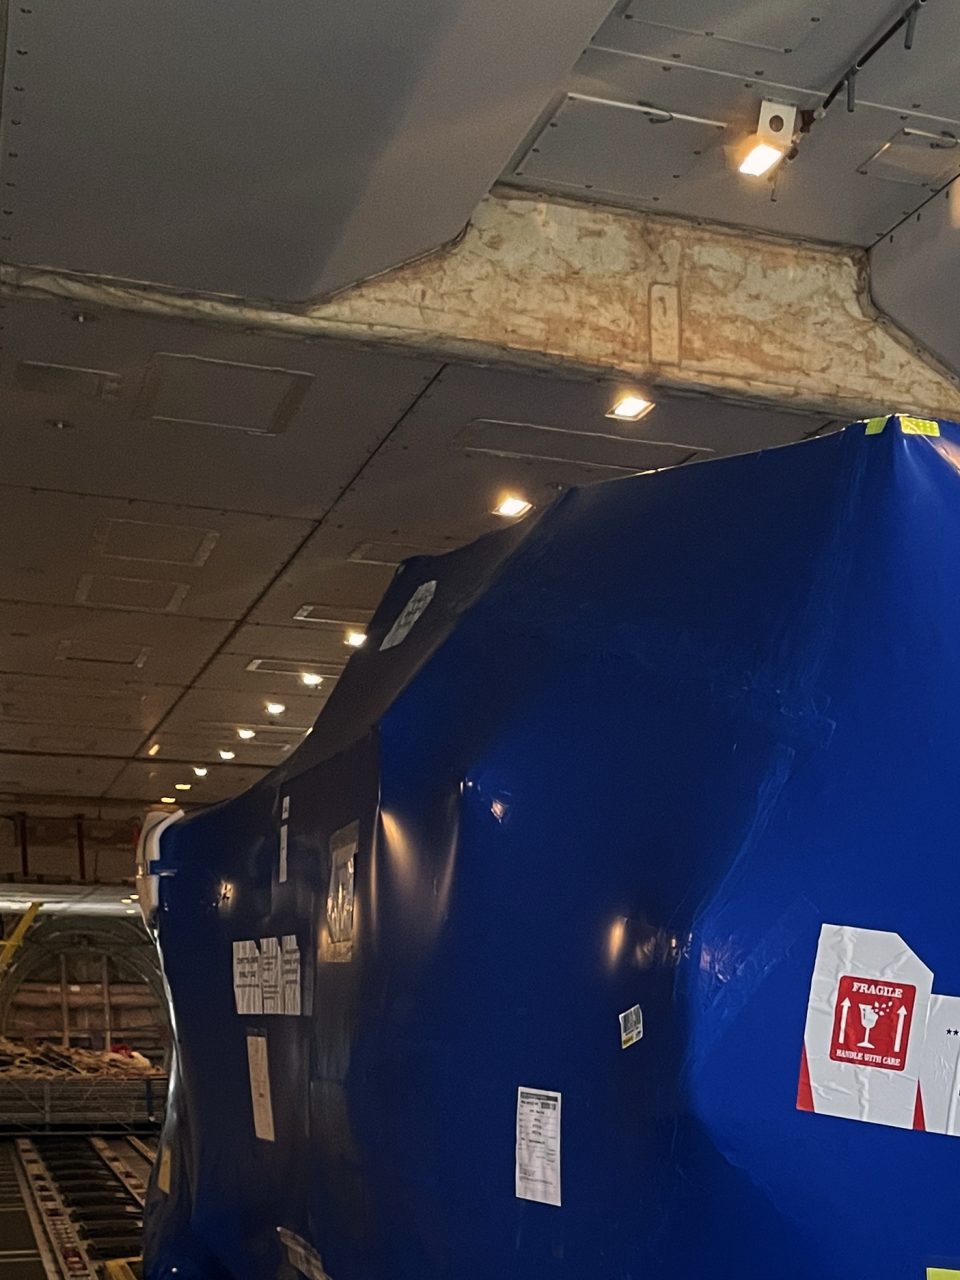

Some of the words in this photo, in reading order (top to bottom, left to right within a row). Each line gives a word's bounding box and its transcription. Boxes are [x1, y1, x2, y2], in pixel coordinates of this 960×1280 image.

[852, 982, 903, 998] FRAGILE
[836, 1049, 863, 1060] HANDLE
[864, 1053, 881, 1062] WITH
[882, 1056, 900, 1066] CARE
